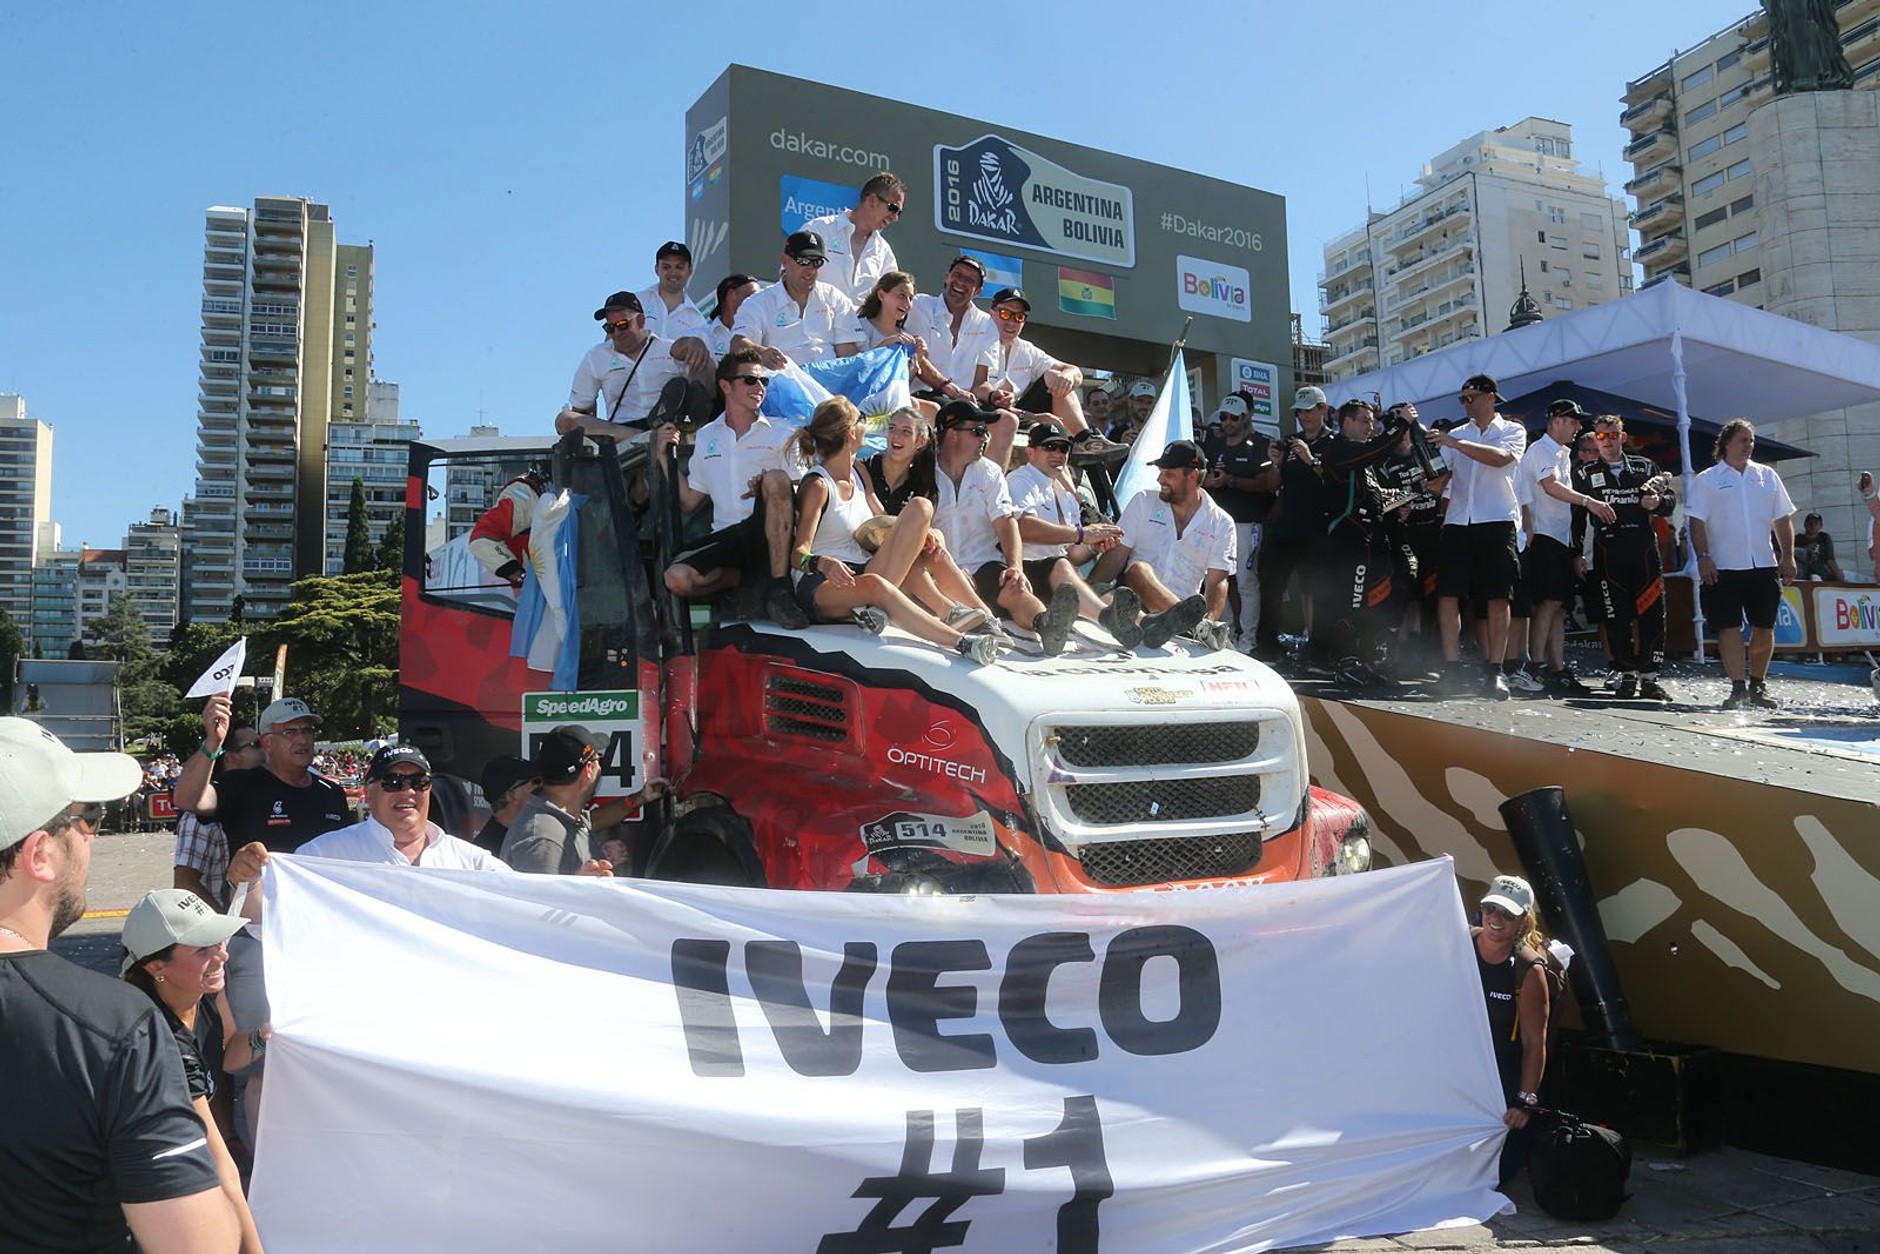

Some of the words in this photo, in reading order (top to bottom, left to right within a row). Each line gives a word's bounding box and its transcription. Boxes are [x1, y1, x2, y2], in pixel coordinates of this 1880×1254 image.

[770, 127, 890, 171] dakar.com
[947, 159, 961, 223] 2016
[1031, 183, 1123, 221] ARGENTINA
[968, 199, 1020, 235] DAKAR
[1063, 217, 1125, 249] BOLIVIA
[1160, 212, 1262, 251] #Dakar2016
[1183, 272, 1245, 304] Bolivia
[1241, 384, 1269, 396] TOTAL
[1352, 564, 1367, 608] IVECO
[1601, 580, 1615, 619] IVECO
[1835, 598, 1880, 630] Bolivi
[536, 698, 628, 717] SpeedAgro
[384, 747, 414, 758] IVECO
[887, 747, 986, 784] OPTITECH
[901, 823, 947, 838] 514
[964, 834, 988, 842] BOLIVIA
[671, 924, 1222, 1078] IVECO
[1490, 991, 1512, 1001] IVECO
[815, 1094, 1114, 1254] #1
